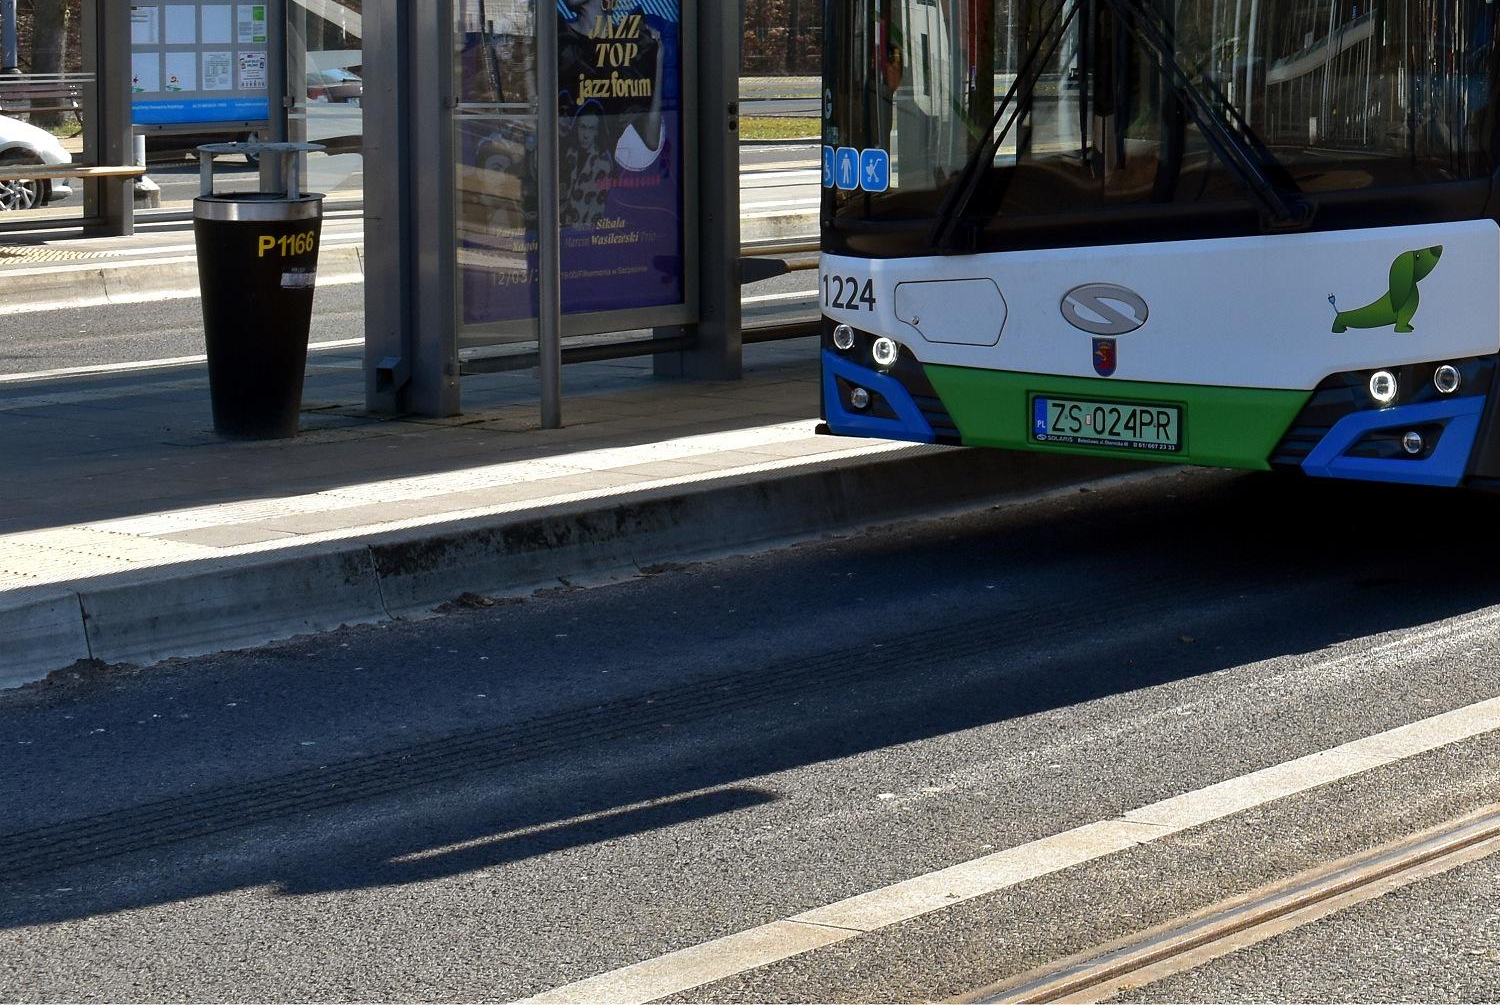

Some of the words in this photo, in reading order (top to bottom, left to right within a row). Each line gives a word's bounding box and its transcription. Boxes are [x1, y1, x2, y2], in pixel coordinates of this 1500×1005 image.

[588, 14, 642, 40] JAZZ
[595, 42, 639, 68] TOP
[576, 73, 610, 106] jazz
[610, 70, 652, 98] forum
[822, 274, 877, 312] 1224
[1037, 419, 1046, 429] PL
[1051, 402, 1083, 433] ZS
[1093, 406, 1170, 441] 024PR
